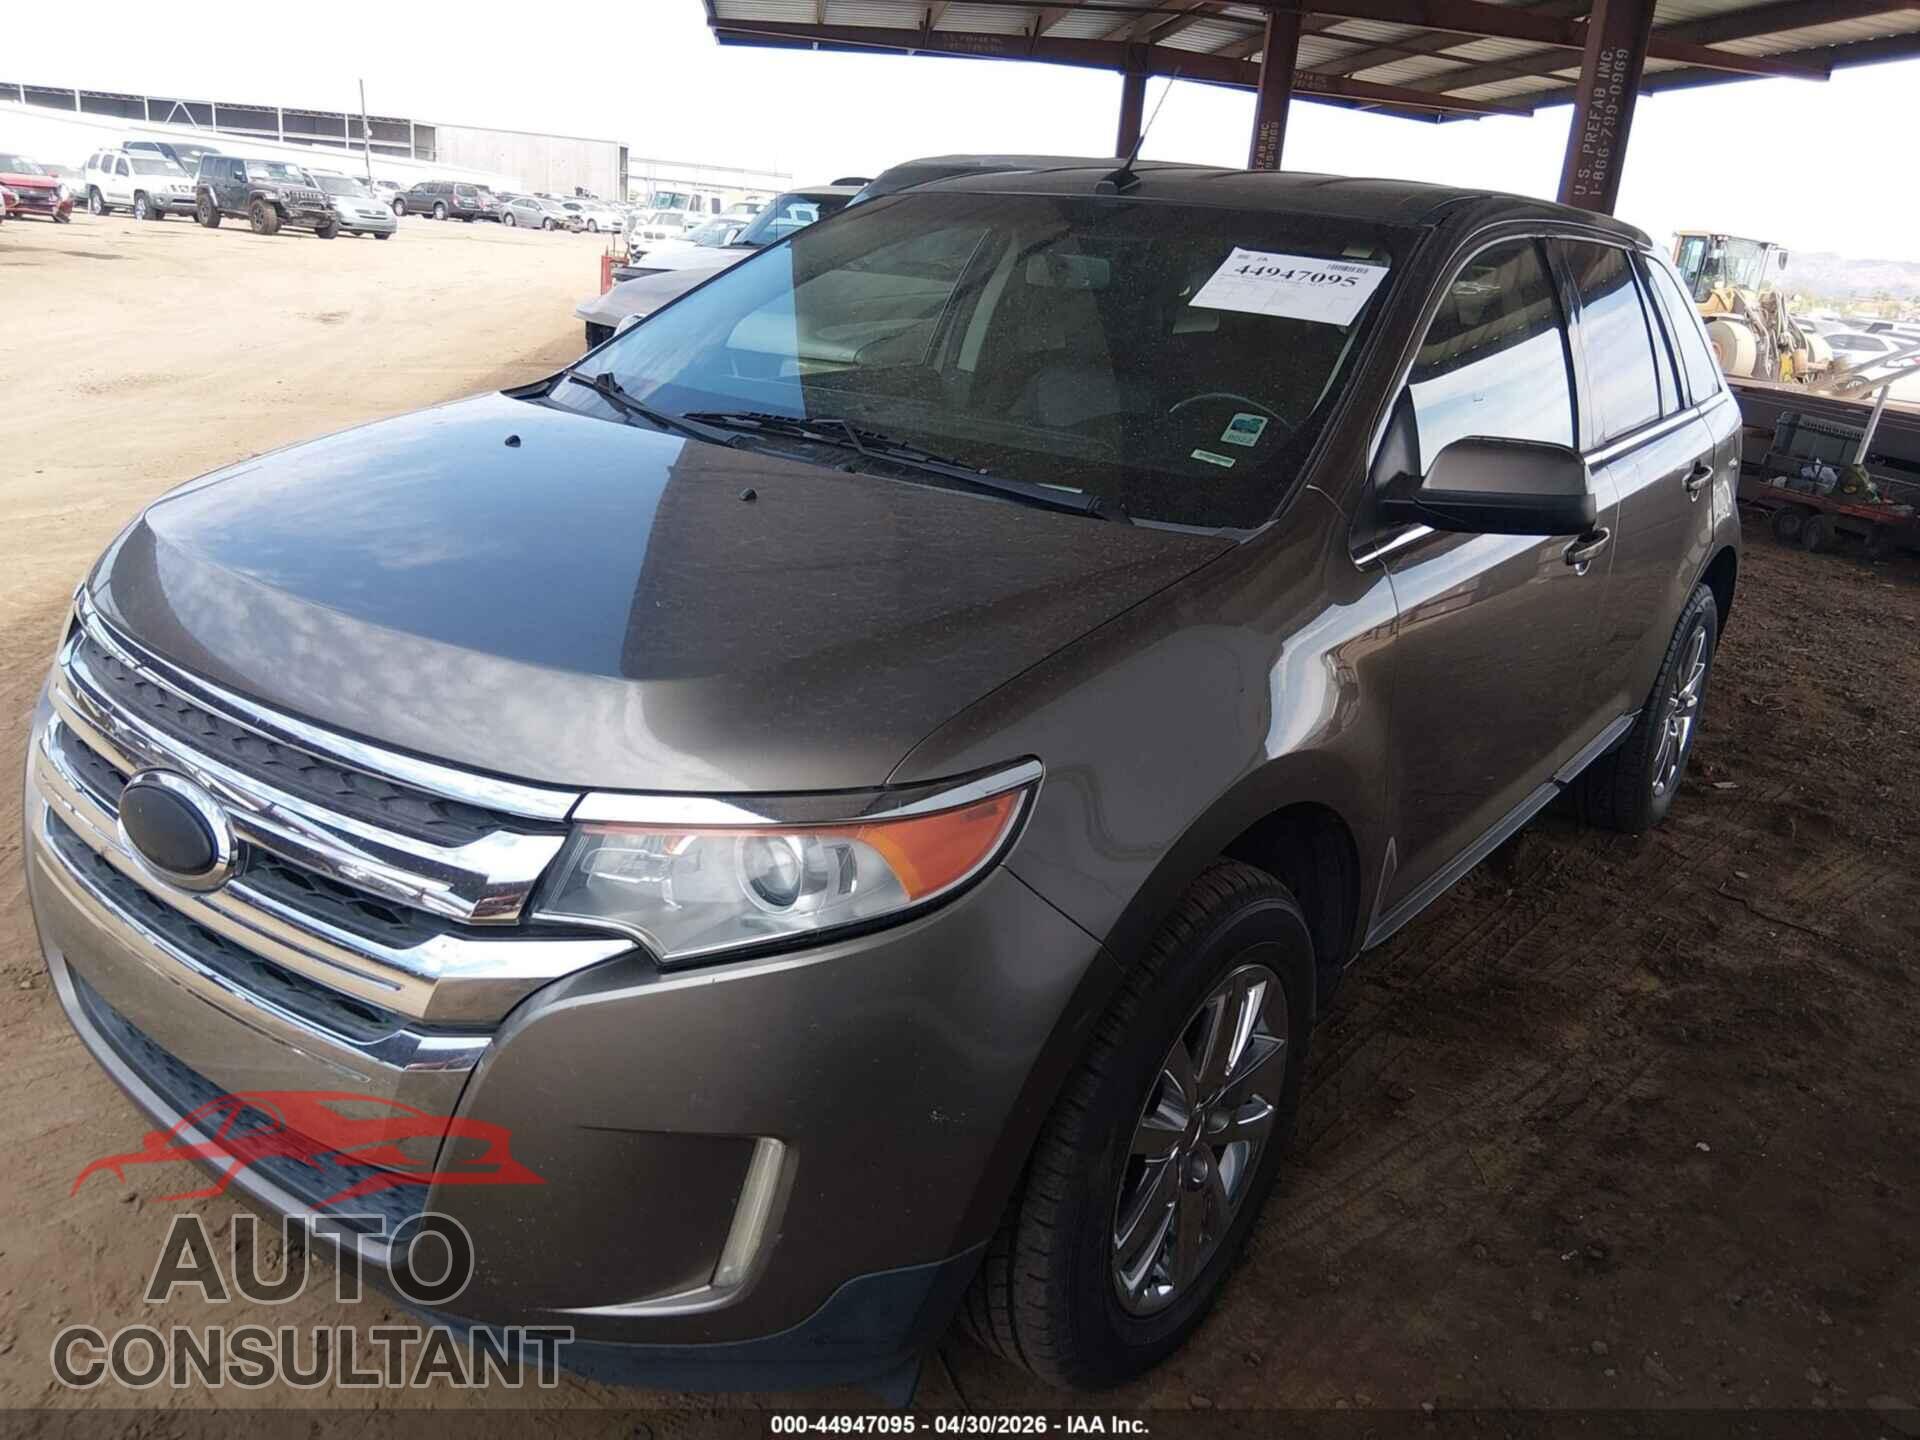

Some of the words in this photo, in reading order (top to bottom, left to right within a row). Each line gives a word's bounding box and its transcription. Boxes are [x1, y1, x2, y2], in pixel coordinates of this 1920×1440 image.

[1582, 88, 1607, 154] PREFAB
[1590, 48, 1629, 196] 1-866-799-0969
[1574, 162, 1593, 196] U.S.
[1234, 263, 1360, 289] 44947095
